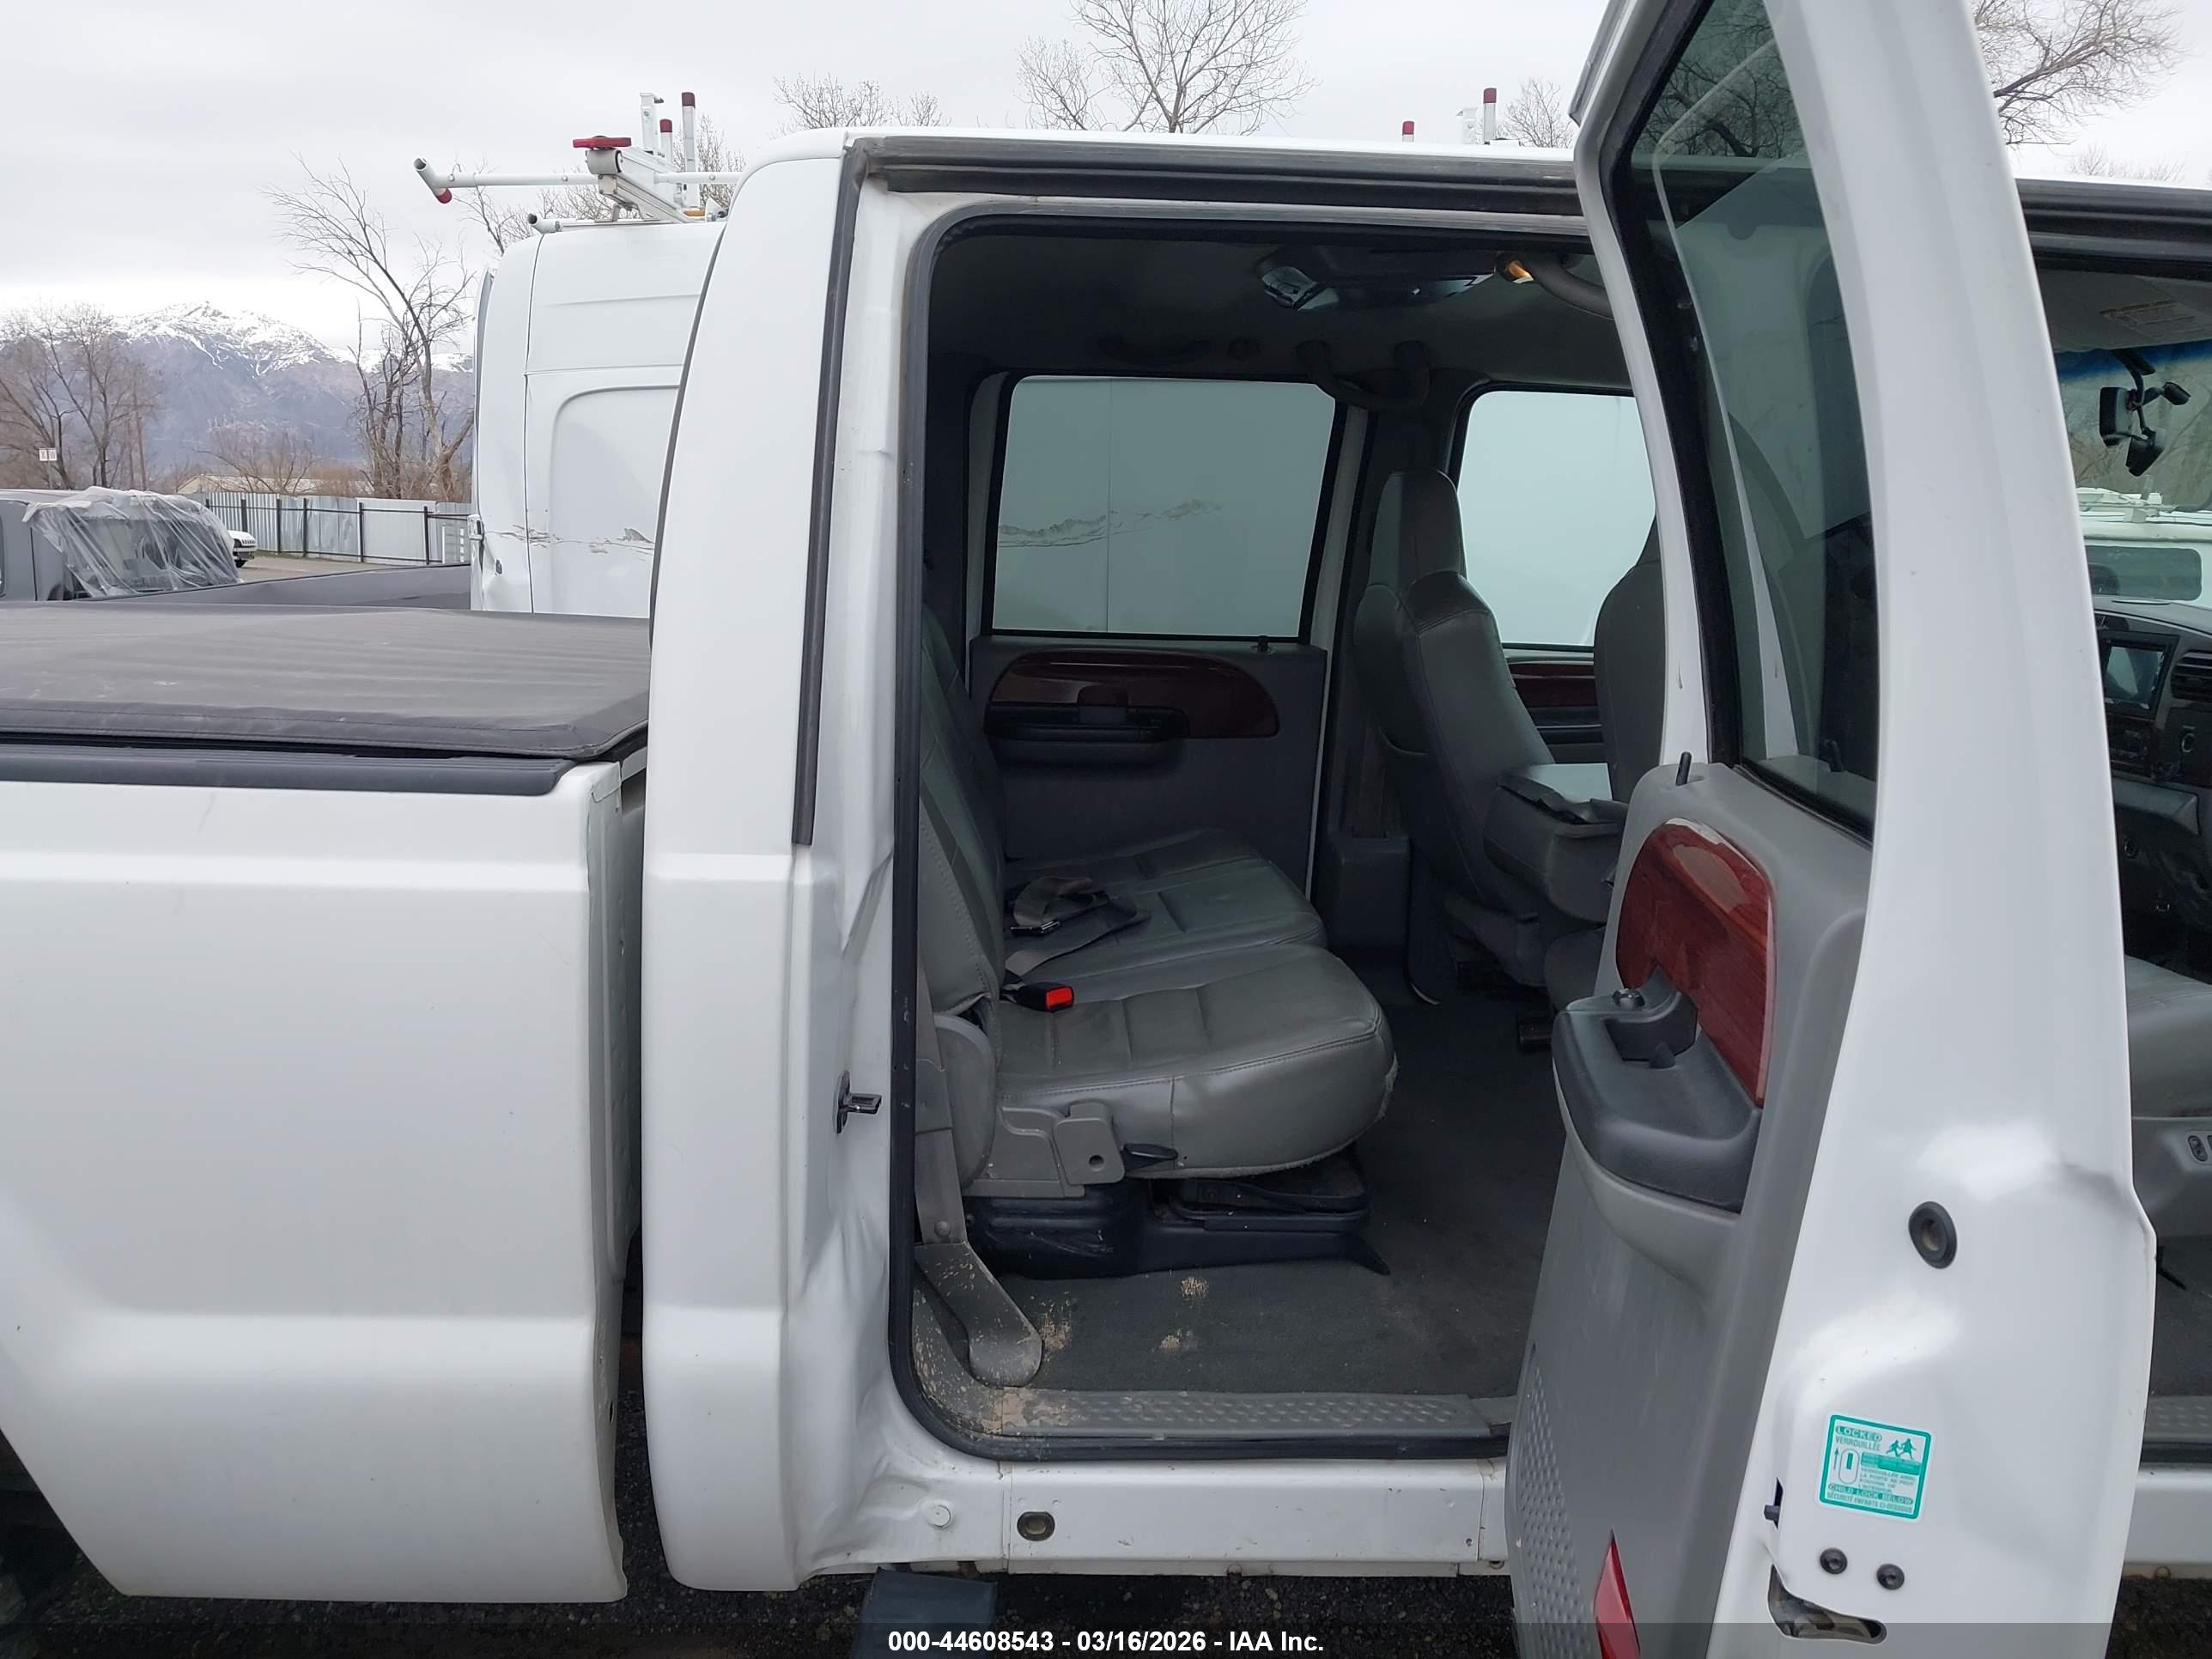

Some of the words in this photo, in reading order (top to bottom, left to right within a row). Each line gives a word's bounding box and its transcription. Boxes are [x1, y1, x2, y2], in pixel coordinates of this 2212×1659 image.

[1837, 1425, 1881, 1442] LOCKED
[1828, 1483, 1854, 1494] CHILD
[1856, 1488, 1879, 1498] LOCK
[1881, 1493, 1912, 1504] BELOW
